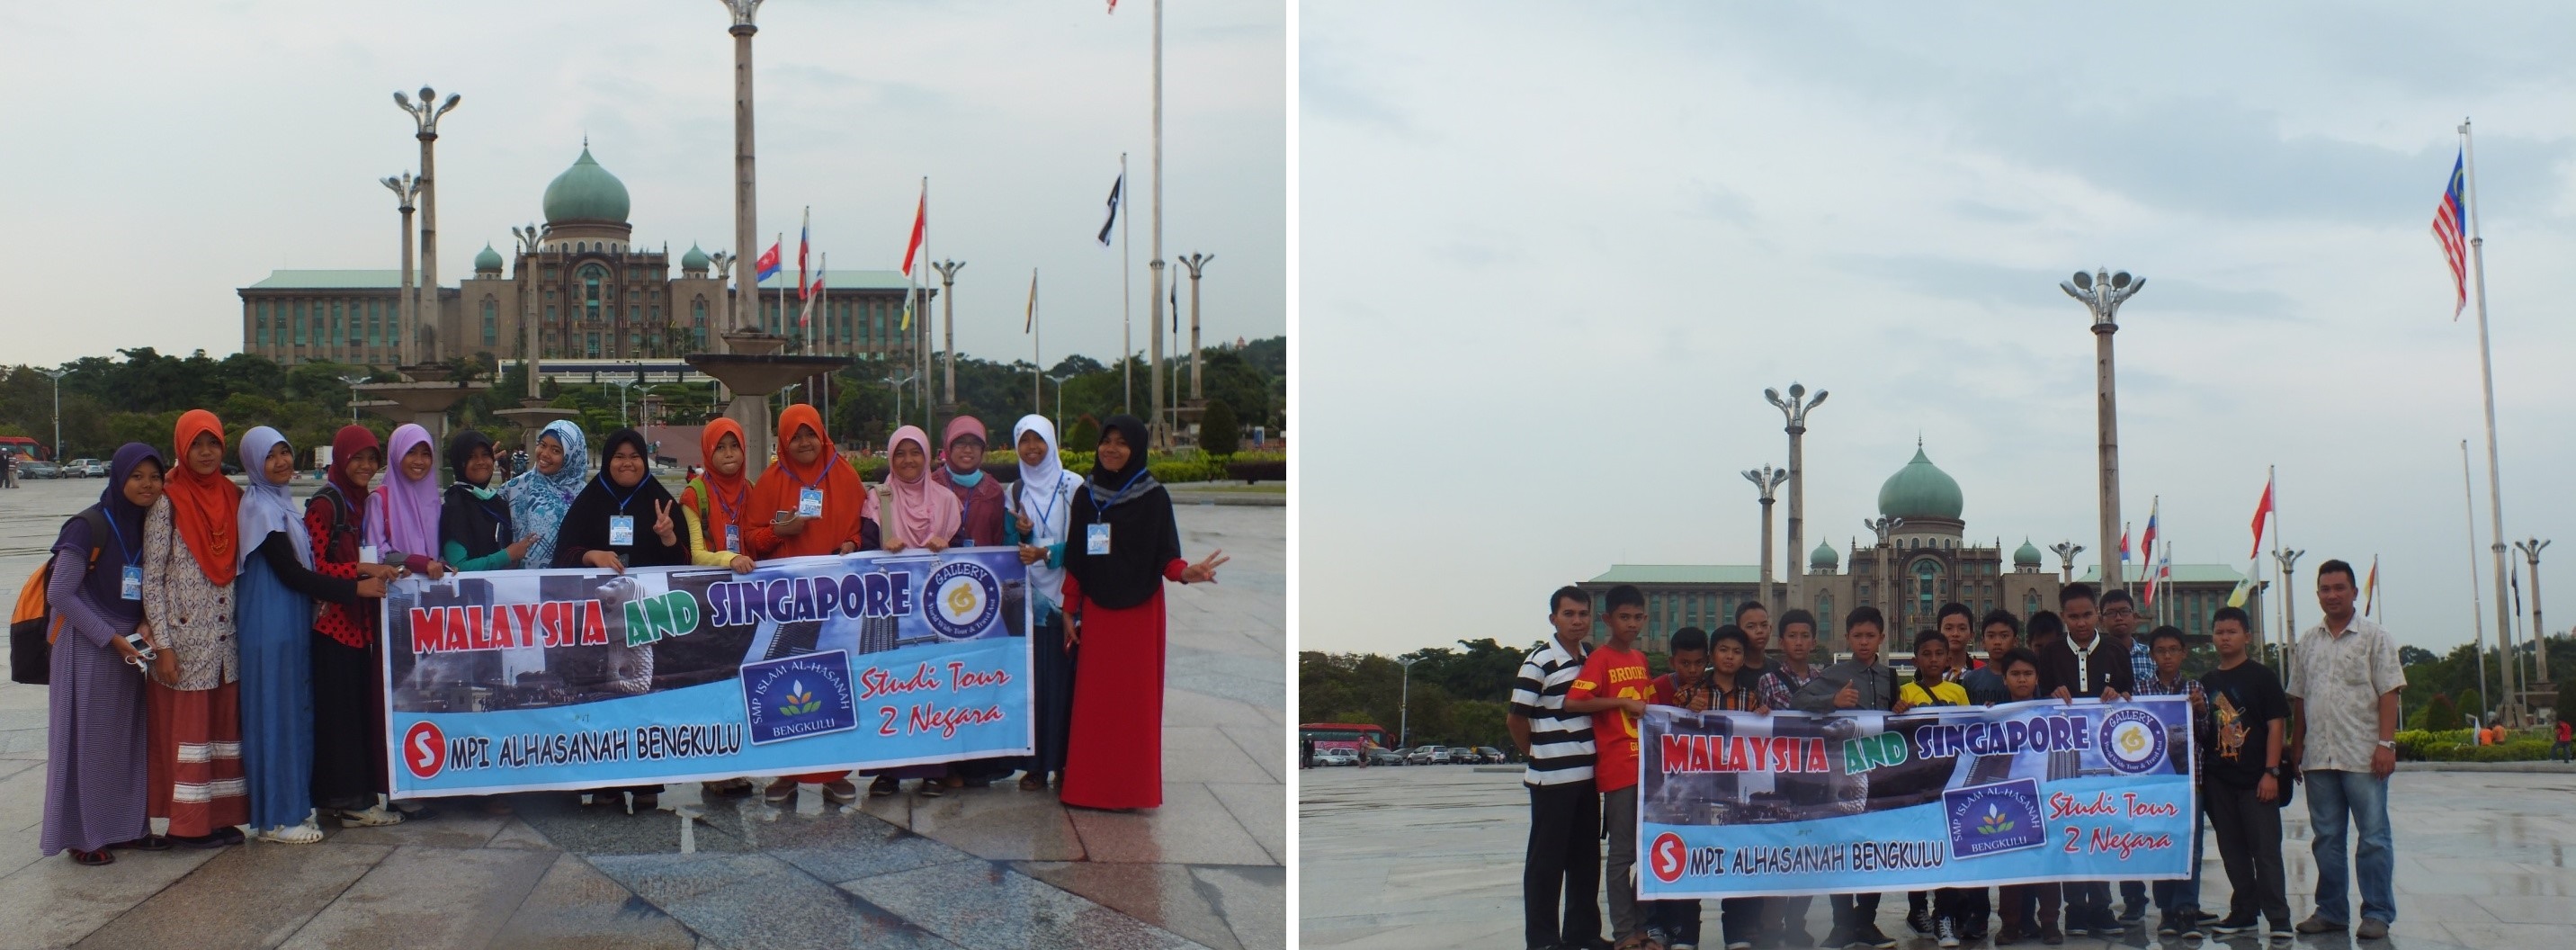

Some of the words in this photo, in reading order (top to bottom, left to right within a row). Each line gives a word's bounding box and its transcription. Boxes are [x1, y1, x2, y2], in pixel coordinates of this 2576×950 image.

[935, 564, 988, 585] GALLERY
[409, 598, 609, 654] MALAYSIA
[623, 589, 700, 648] AND
[707, 571, 912, 627] SINGAPORE
[976, 612, 992, 628] Travel
[756, 665, 787, 695] ISLAM
[792, 660, 850, 710] AL-HASANAH
[860, 661, 941, 702] Studi
[947, 662, 1011, 694] Tour
[752, 697, 763, 724] SMP
[879, 705, 899, 737] 2
[908, 702, 1005, 739] Negara
[2109, 711, 2153, 728] GALLERY
[773, 718, 836, 737] BENGKULU
[498, 729, 629, 768] ALHASANAH
[636, 722, 742, 759] BENGKULU
[1660, 733, 1829, 775] MALAYSIA
[1844, 730, 1908, 775] AND
[1915, 715, 2090, 759] SINGAPORE
[1956, 791, 1983, 817] ISLAM
[1987, 787, 2040, 828] AL-HASANAH
[2048, 791, 2117, 820] Studi
[2123, 793, 2178, 819] Tour
[1953, 819, 1963, 842] SMP
[1972, 836, 2026, 852] BENGKULU
[2063, 827, 2082, 854] 2
[2089, 826, 2172, 861] Negara
[1731, 841, 1845, 875] ALHASANAH
[1851, 840, 1945, 872] BENGKULU
